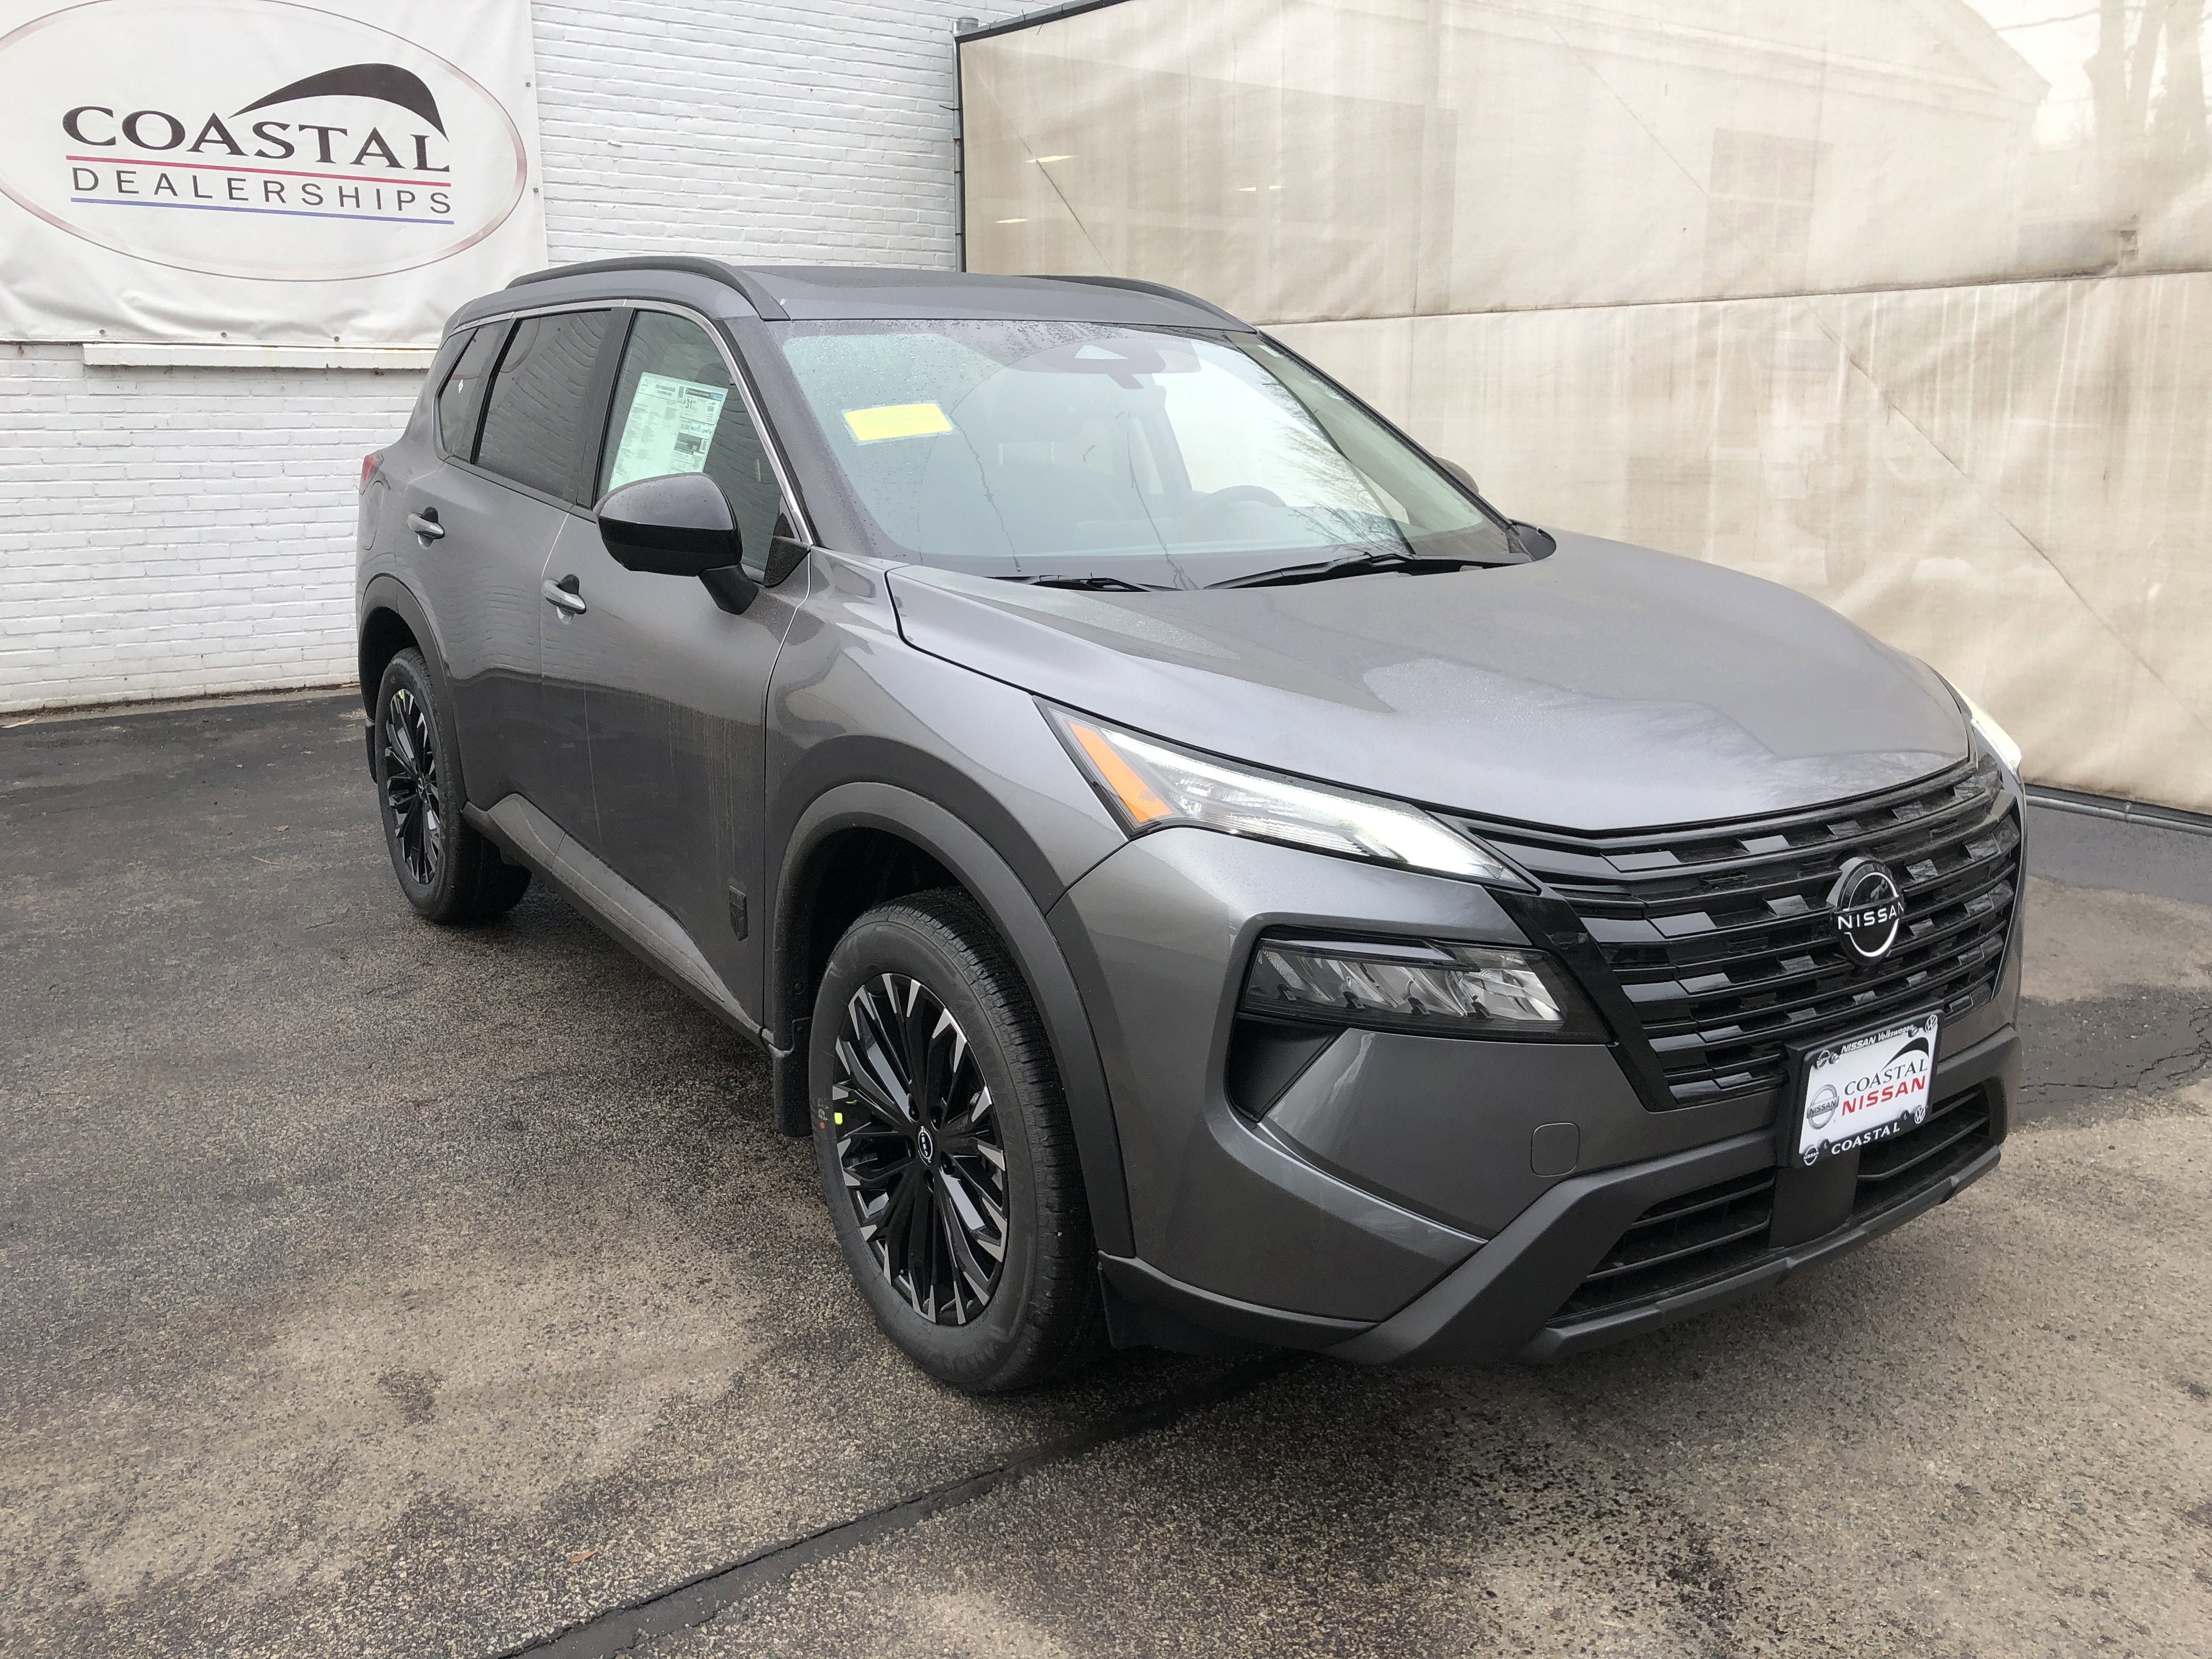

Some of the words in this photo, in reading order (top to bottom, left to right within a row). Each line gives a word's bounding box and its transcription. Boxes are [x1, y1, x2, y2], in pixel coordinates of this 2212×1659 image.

[63, 106, 450, 172] COASTAL
[72, 167, 452, 214] DEALERSHIPS
[1838, 901, 1904, 930] NISSAN
[1841, 1036, 1876, 1054] NISSAN
[1844, 1058, 1928, 1096] COASTAL
[1810, 1100, 1836, 1114] NISSAN
[1842, 1075, 1926, 1116] NISSAN
[1831, 1122, 1900, 1154] COASTAL
